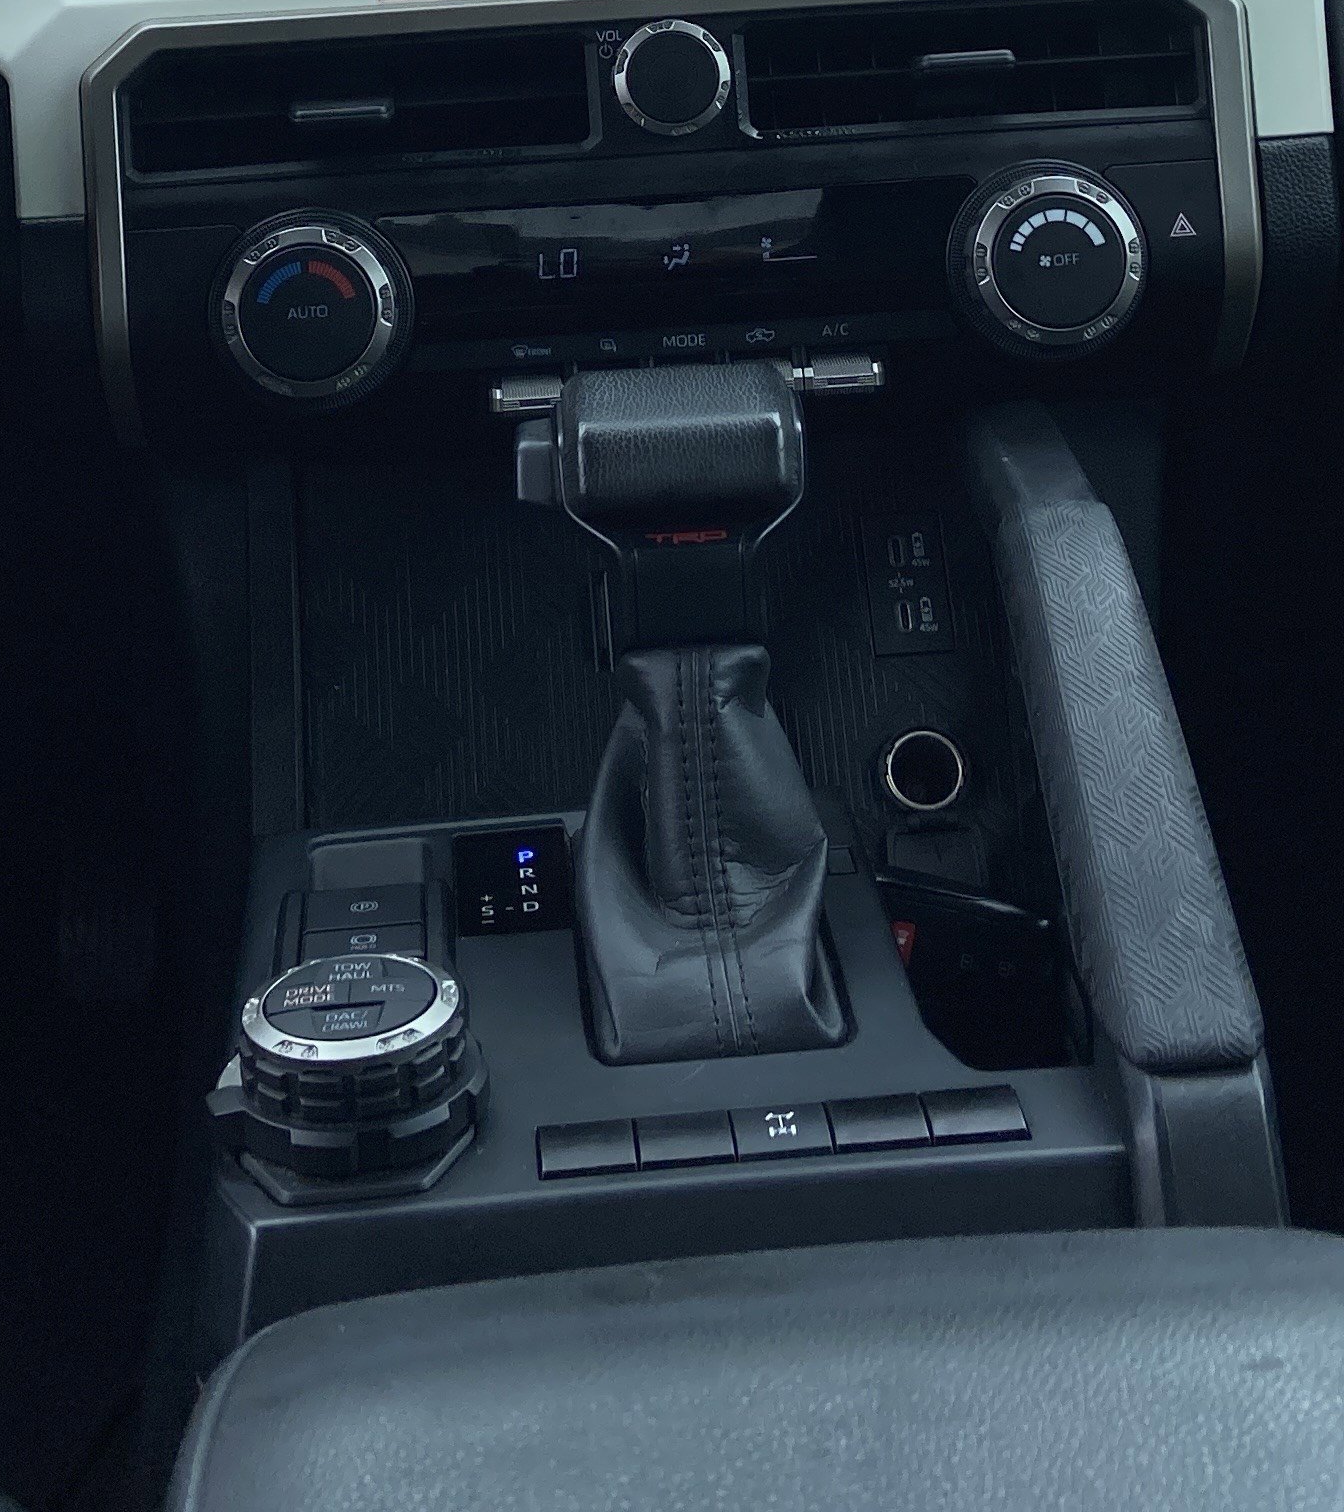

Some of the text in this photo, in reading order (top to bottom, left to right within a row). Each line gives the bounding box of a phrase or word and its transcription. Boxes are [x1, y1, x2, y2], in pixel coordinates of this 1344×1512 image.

[596, 30, 623, 42] VOL
[1053, 253, 1080, 266] OFF
[287, 304, 328, 320] AUTO
[822, 323, 849, 337] A/C
[662, 333, 706, 347] MODE
[518, 850, 534, 863] P
[519, 867, 535, 879] R
[521, 884, 538, 895] N
[481, 904, 494, 917] S
[523, 900, 539, 913] D
[334, 962, 371, 972] TOW
[328, 970, 374, 982] HAUL
[286, 984, 335, 998] DRIVE
[370, 983, 406, 993] MTS
[283, 993, 335, 1008] MODE
